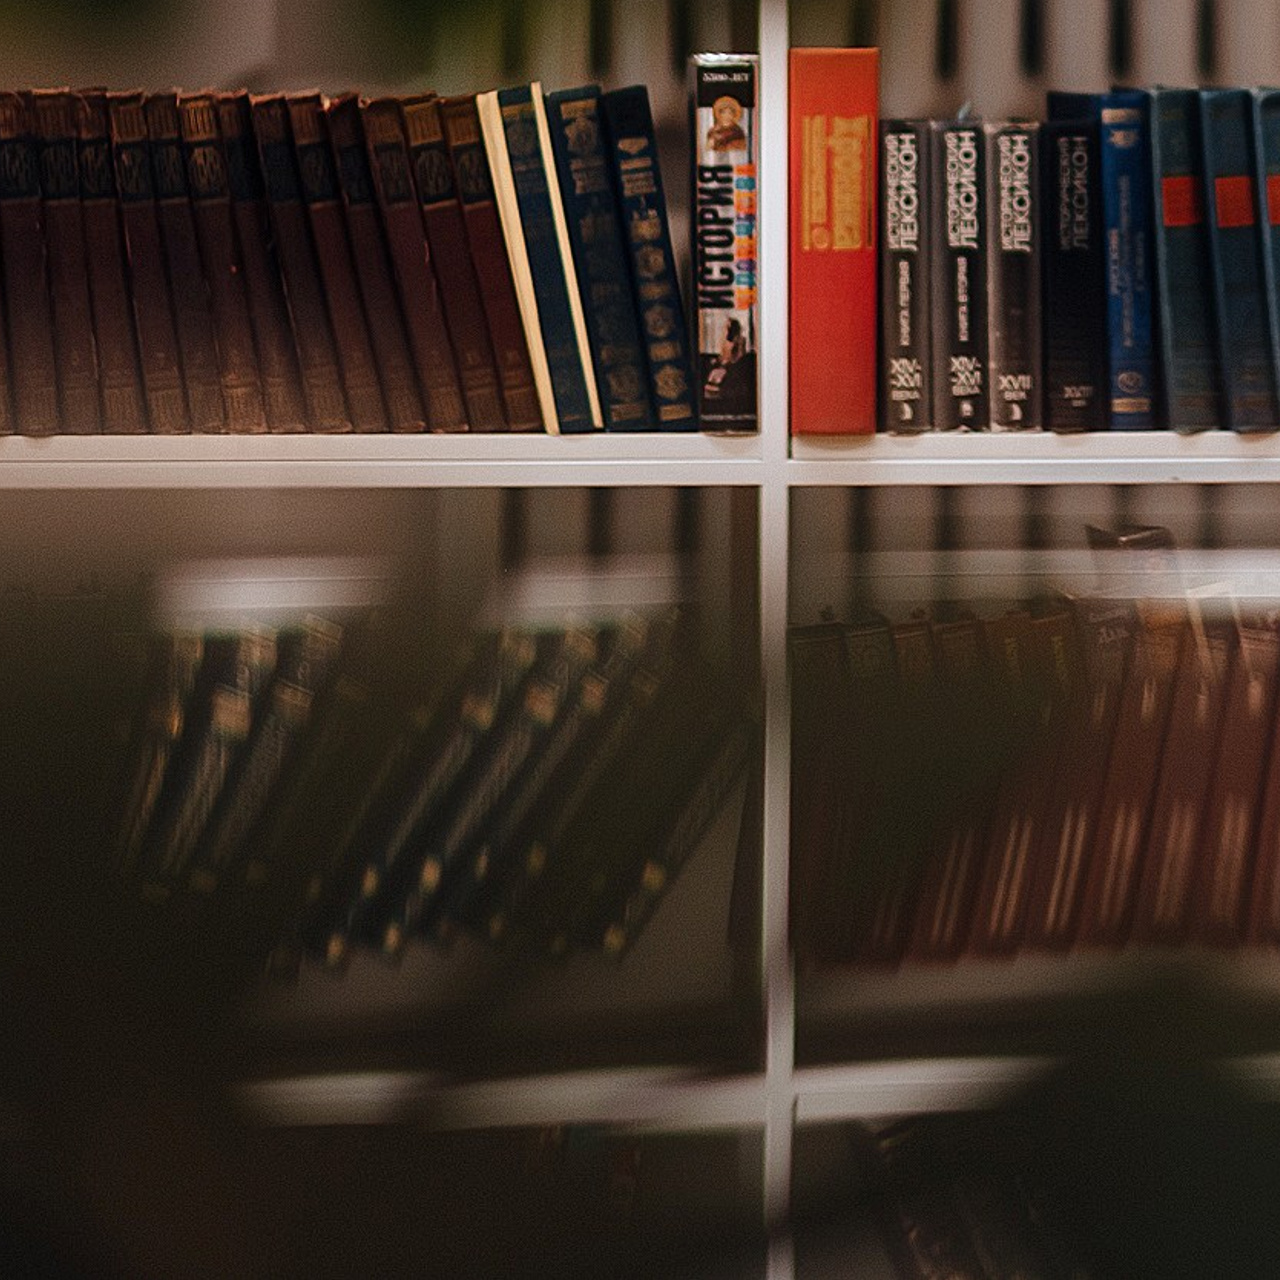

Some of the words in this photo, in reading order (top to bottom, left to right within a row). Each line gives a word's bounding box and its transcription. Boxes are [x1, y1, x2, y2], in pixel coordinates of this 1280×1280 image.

[699, 165, 735, 309] ИСТОРИЯ
[885, 133, 900, 250] ИСТОРИЧЕСКИЙ
[899, 132, 918, 252] ЛЕКСИКОН
[945, 132, 961, 248] ИСТОРИЧЕСКИЙ
[959, 130, 978, 250] ЛЕКСИКОН
[998, 134, 1014, 251] ИСТОРИЧЕСКИЙ
[1012, 133, 1032, 253] ЛЕКСИКОН
[1072, 135, 1089, 251] ЛЕКСИКОН
